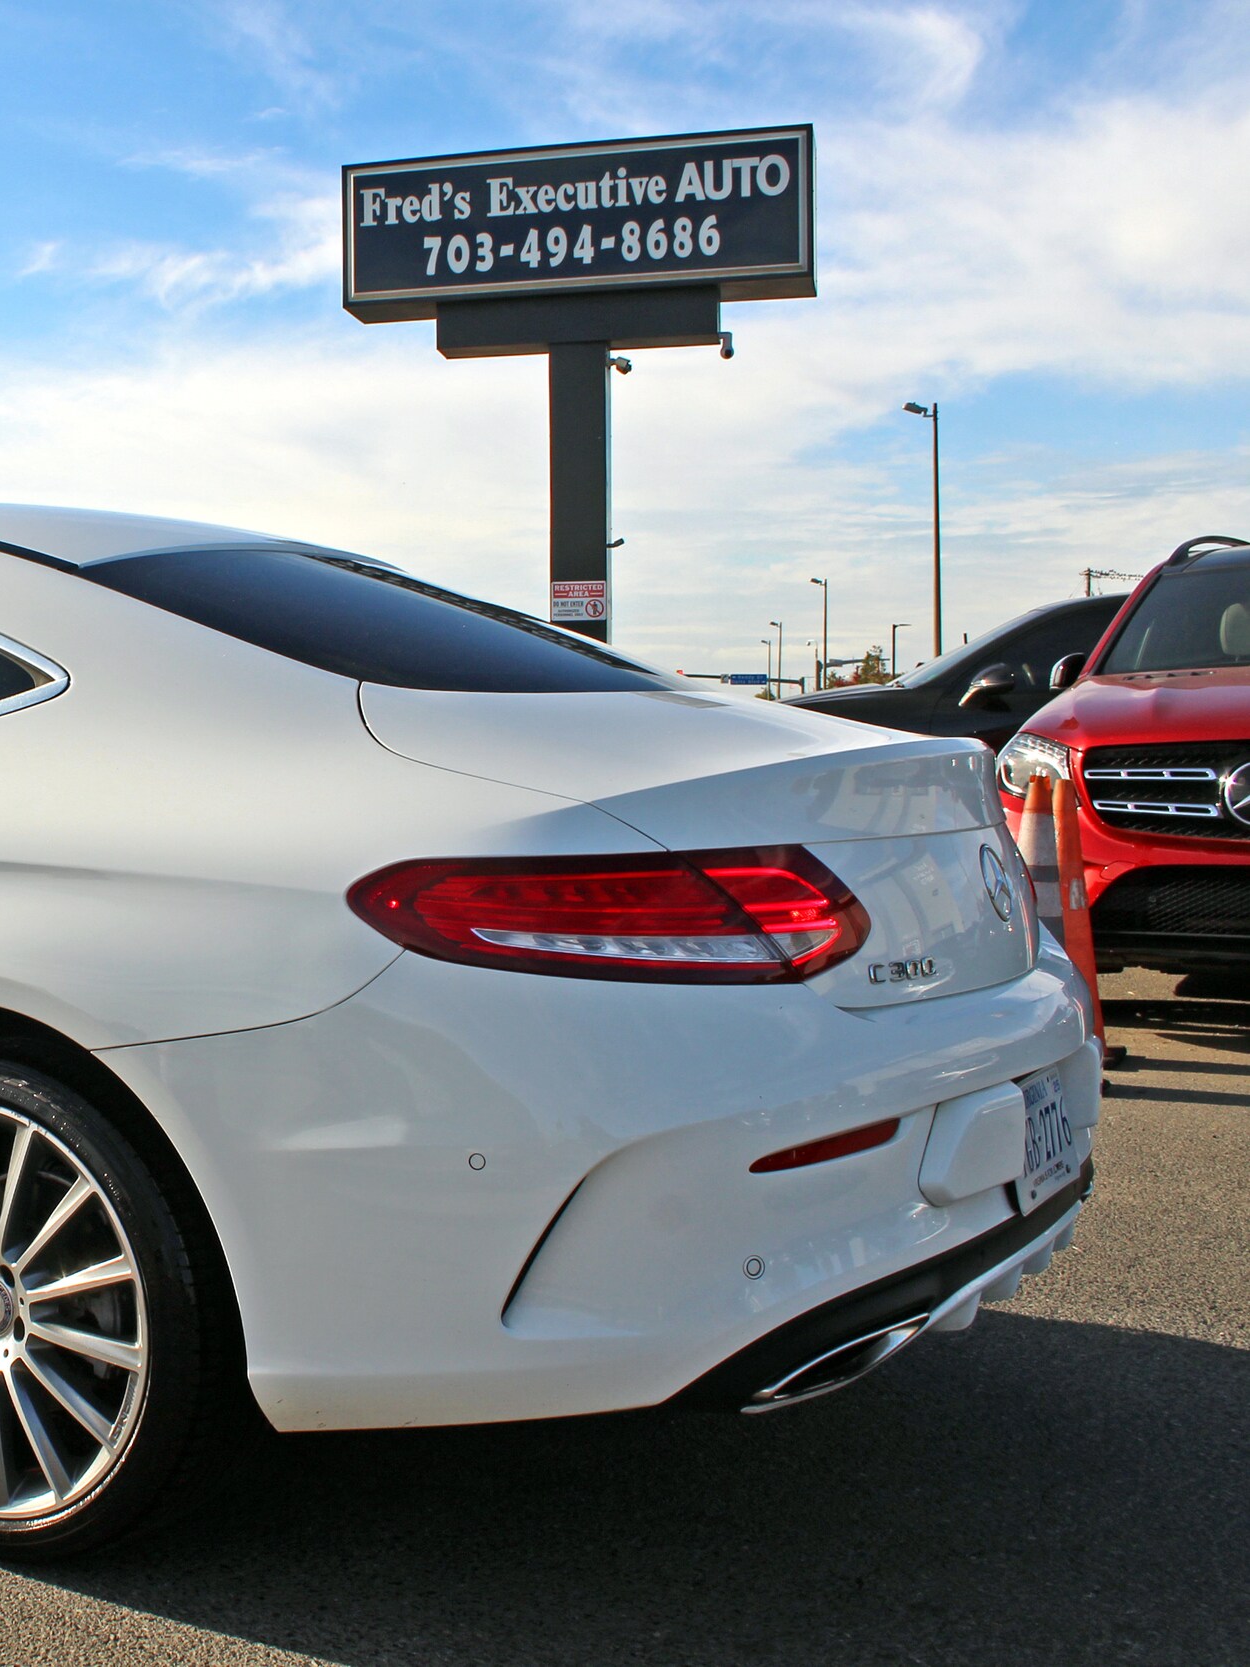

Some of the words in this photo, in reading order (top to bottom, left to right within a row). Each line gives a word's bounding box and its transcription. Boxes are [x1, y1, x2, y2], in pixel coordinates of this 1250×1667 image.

[360, 182, 471, 227] Fred's
[486, 167, 667, 217] Executive
[675, 154, 790, 203] AUTO
[423, 214, 720, 276] 703-494-8686
